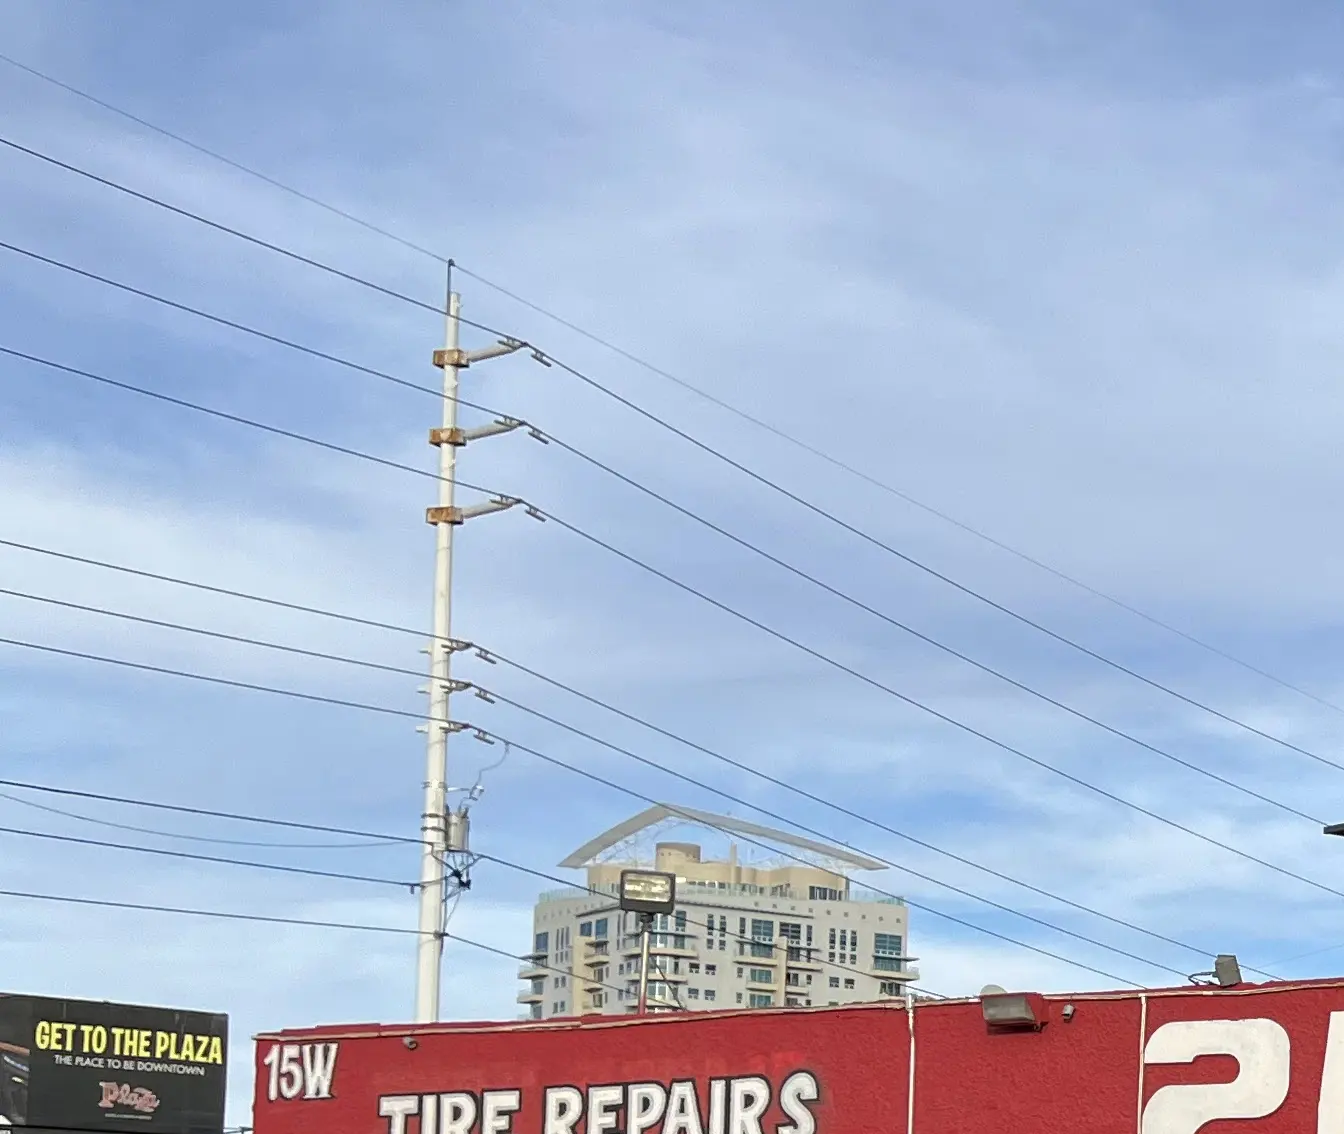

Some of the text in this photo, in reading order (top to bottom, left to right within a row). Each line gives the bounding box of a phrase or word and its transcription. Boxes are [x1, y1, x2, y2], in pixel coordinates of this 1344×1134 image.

[35, 1020, 224, 1065] GET TO THE PLAZA
[54, 1054, 205, 1076] THE PLACE TO BE DOWNTOWN
[263, 1043, 339, 1101] 15W
